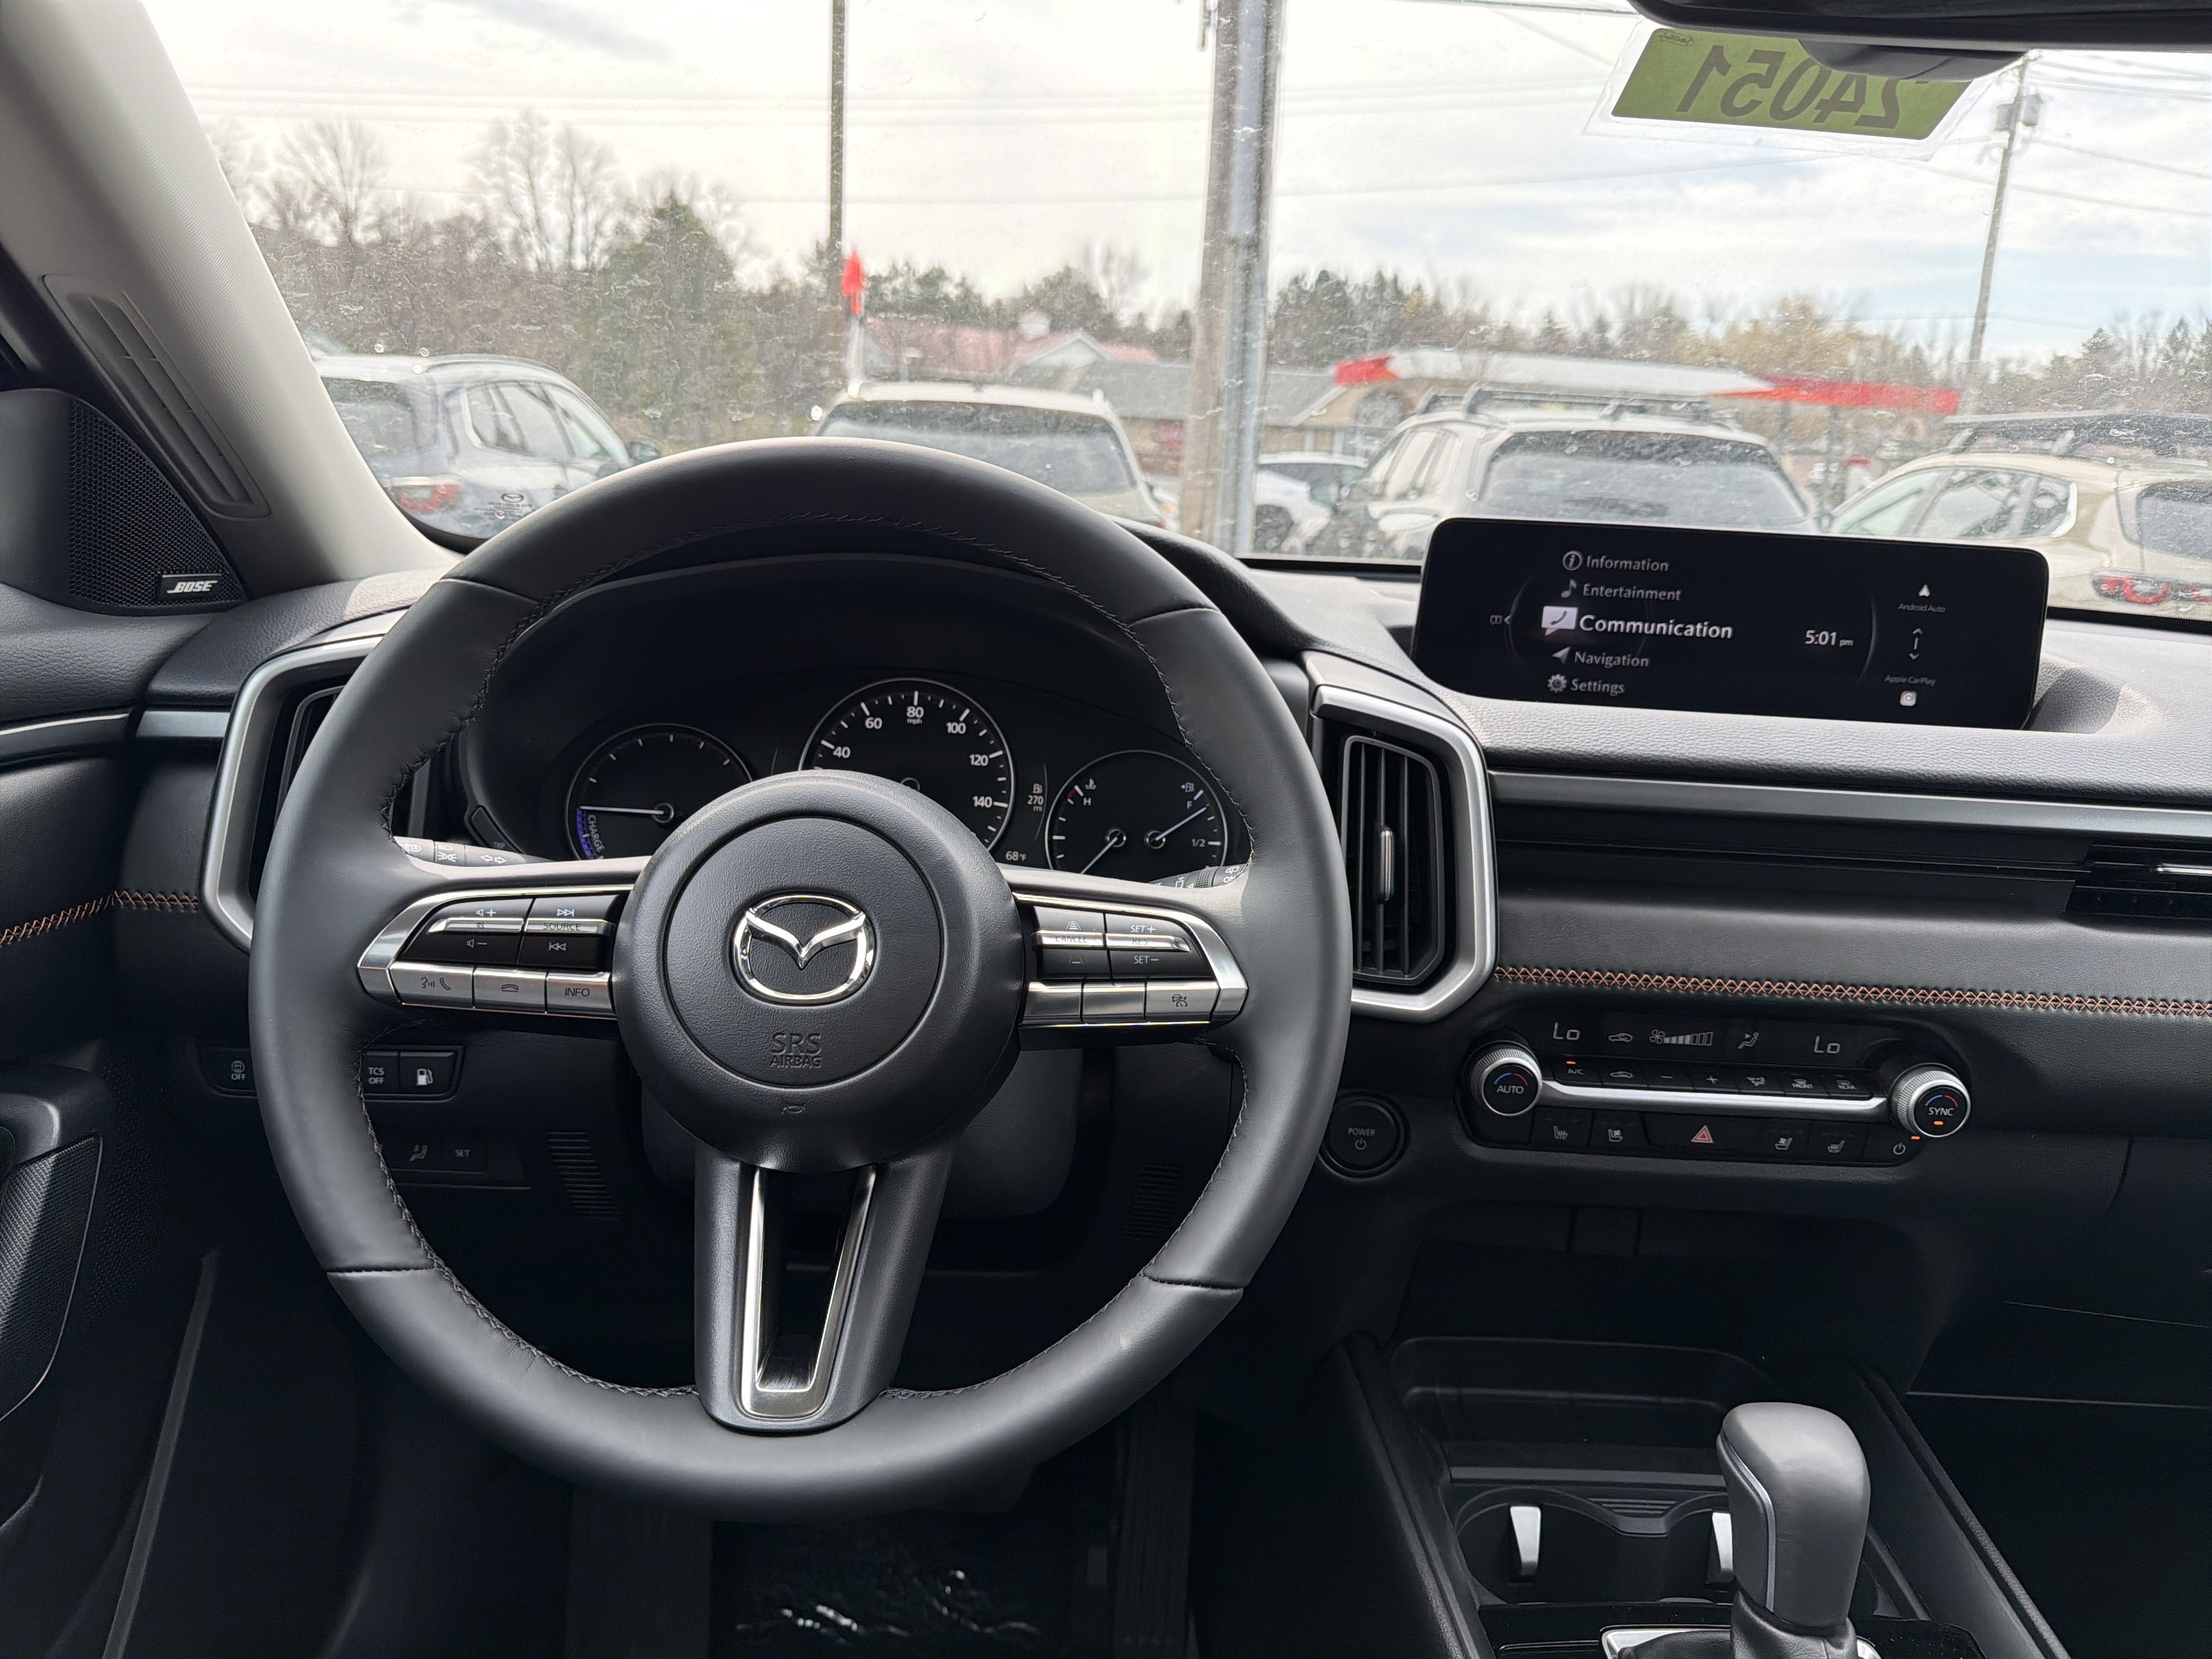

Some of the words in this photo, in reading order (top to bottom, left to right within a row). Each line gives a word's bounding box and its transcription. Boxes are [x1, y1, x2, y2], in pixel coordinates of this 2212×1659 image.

[1586, 555, 1669, 572] Information
[166, 580, 218, 594] BOSE
[1583, 583, 1681, 601] Entertainment
[1898, 602, 1927, 612] Android
[1927, 605, 1946, 613] Auto
[1579, 614, 1734, 639] Communication
[1804, 629, 1837, 646] 5:01
[1839, 638, 1854, 647] pm
[1574, 650, 1650, 669] Navigation
[1884, 674, 1907, 685] Apple
[1908, 676, 1936, 686] CarPlay
[1570, 678, 1626, 697] Settings
[906, 706, 924, 718] 80
[865, 716, 883, 730] 60
[946, 722, 967, 735] 100
[833, 747, 851, 759] 40
[969, 754, 989, 766] 120
[973, 795, 992, 809] 140
[1027, 795, 1044, 806] 270
[1083, 797, 1092, 806] H
[1186, 801, 1193, 809] F
[588, 814, 606, 853] CHARGE
[1191, 838, 1206, 848] 1/2
[543, 922, 581, 932] SOURCE
[1054, 934, 1088, 943] CANCEL
[564, 986, 591, 997] INFO
[1553, 1022, 1581, 1041] Lo
[771, 1031, 823, 1056] SRS
[1814, 1035, 1841, 1054] Lo
[769, 1054, 822, 1069] AIRBAG
[231, 1073, 246, 1081] OFF
[368, 1066, 385, 1076] TCS
[1567, 1067, 1584, 1076] A/C
[368, 1076, 385, 1085] OFF
[1496, 1084, 1525, 1095] AUTO
[1928, 1107, 1955, 1117] SYNC
[1347, 1127, 1375, 1137] POWER
[455, 1149, 471, 1158] SET
